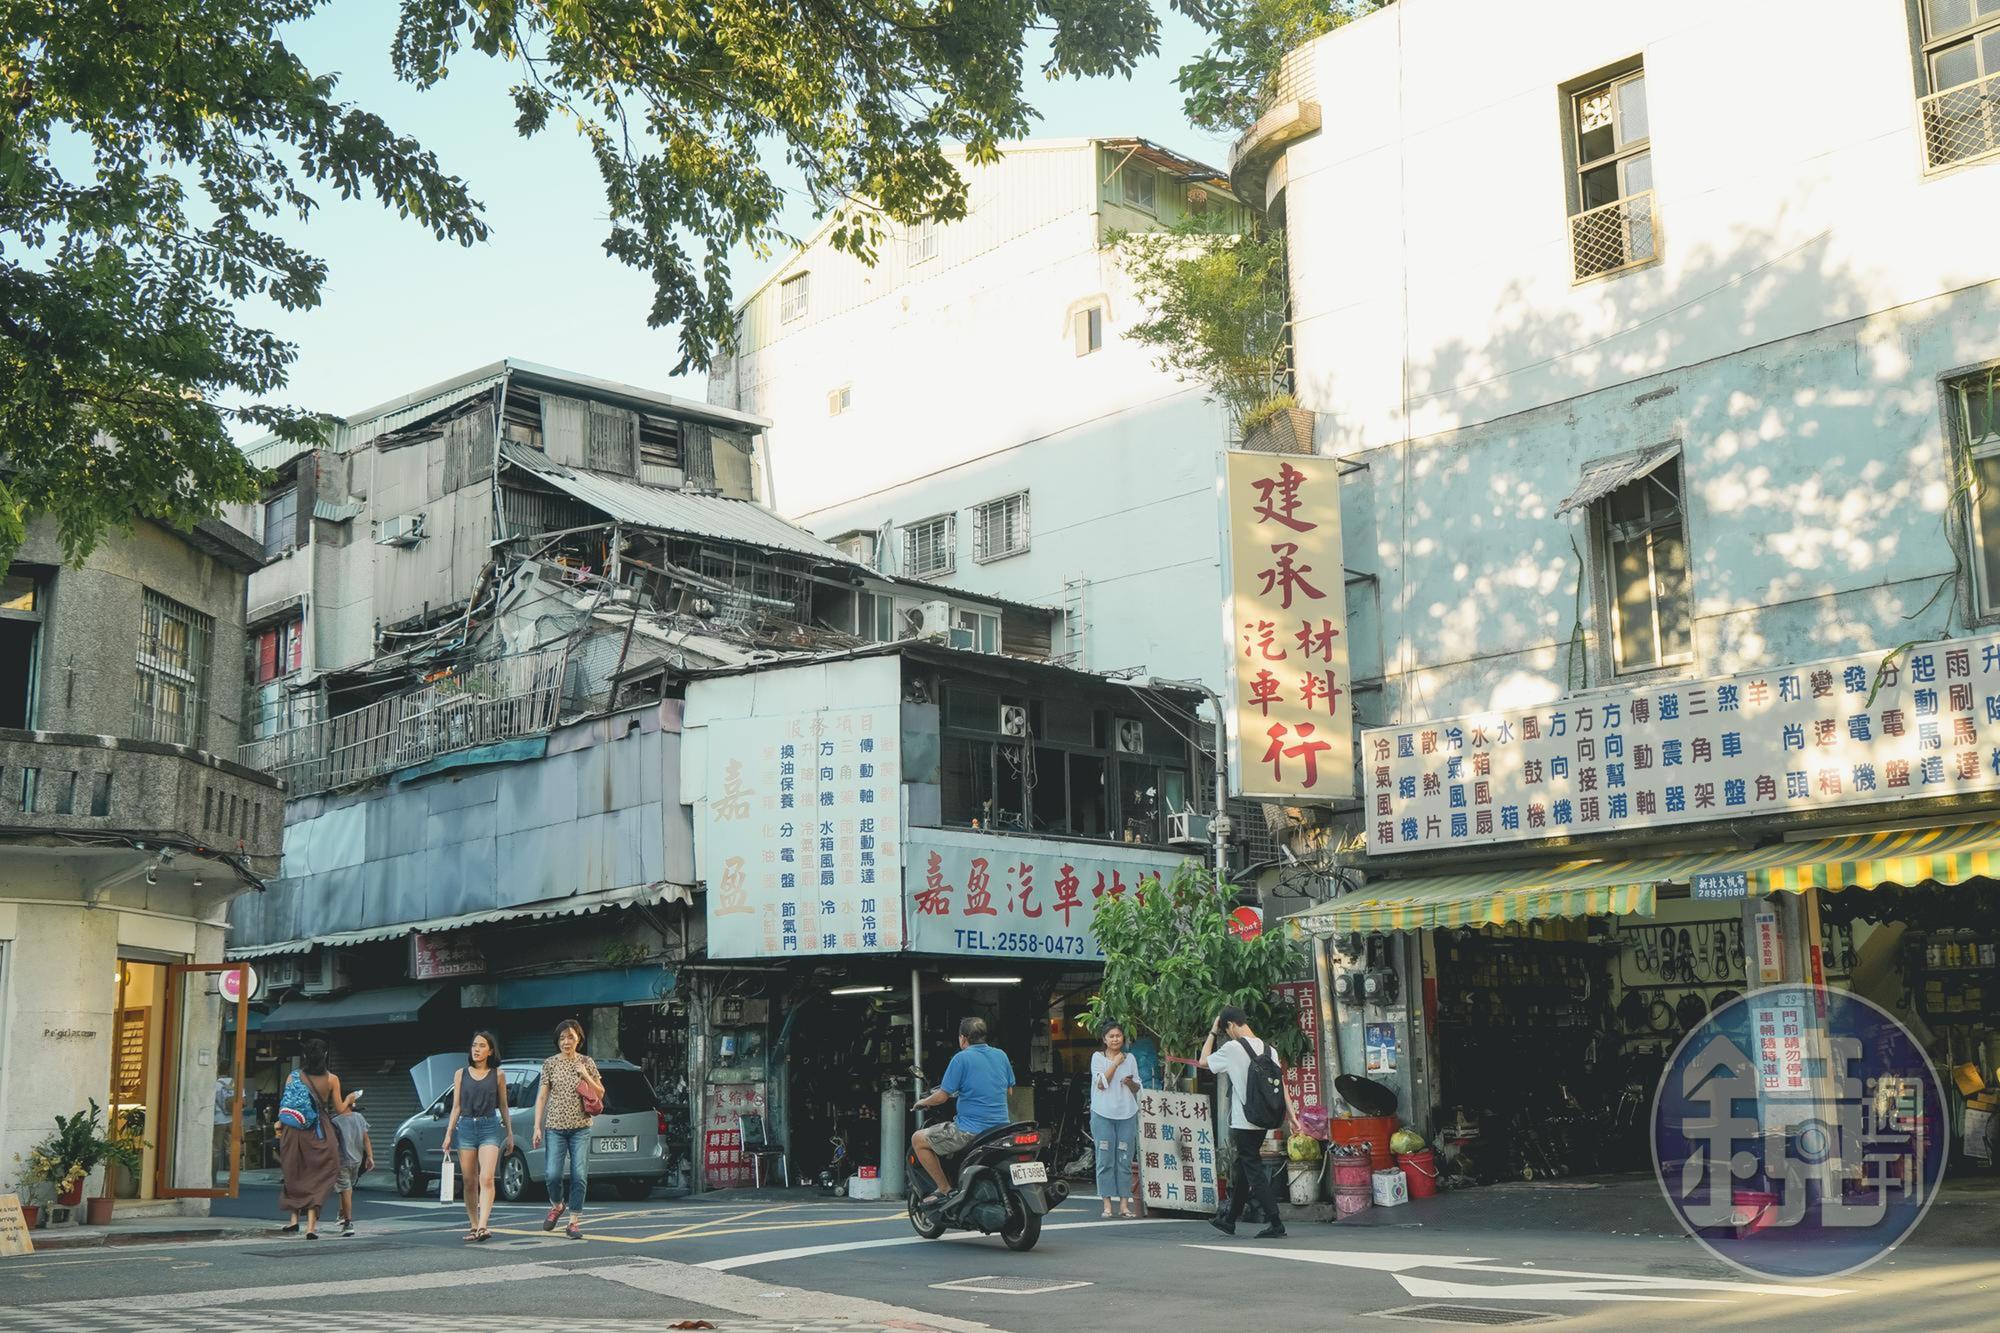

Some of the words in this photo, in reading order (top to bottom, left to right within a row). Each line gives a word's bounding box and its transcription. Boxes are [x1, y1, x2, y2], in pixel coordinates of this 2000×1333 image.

[1251, 462, 1327, 609] 建承
[1261, 722, 1331, 788] 行
[1549, 711, 1573, 825] 方向機
[1575, 707, 1600, 823] 方向接頭
[1602, 703, 1628, 819] 方向幫浦
[1630, 698, 1656, 816] 傳動軸
[1658, 693, 1685, 813] 避震器
[1688, 690, 1715, 809] 三角架
[1717, 684, 1746, 807] 煞車盤
[1748, 679, 1777, 801] 羊角
[1779, 675, 1809, 799] 和尚頭
[1810, 669, 1842, 795] 變速箱
[1843, 665, 1876, 792] 發電機
[1878, 660, 1910, 788] 分電盤
[1911, 654, 1945, 785] 起動馬達
[1946, 648, 1982, 781] 雨刷馬達
[780, 745, 794, 809] 換油保養
[820, 741, 834, 806] 方向機
[860, 738, 874, 803] 傳動軸
[1374, 738, 1394, 844] 冷氣風箱
[1397, 733, 1418, 841] 壓縮機
[1421, 730, 1442, 839] 散熱片
[1445, 727, 1468, 838] 冷氣風扇
[1471, 724, 1493, 835] 水箱風扇
[1497, 720, 1519, 830] 水箱
[1522, 716, 1546, 828] 風鼓機
[711, 758, 755, 917] 嘉盈
[780, 822, 795, 888] 分電盤
[820, 820, 834, 886] 水箱風扇
[860, 818, 875, 884] 起動馬達
[781, 902, 797, 951] 節氣門
[821, 900, 836, 949] 冷排
[861, 899, 877, 947] 加冷煤
[954, 929, 1084, 954] TEL:2558-0473
[1698, 887, 1745, 898] 28951080
[1760, 1012, 1779, 1088] 車輛隨時進出
[1782, 1010, 1802, 1087] 門前請勿停車
[1785, 995, 1797, 1004] 39
[1141, 1095, 1208, 1121] 建承汽材
[1144, 1122, 1162, 1199] 壓縮機
[1161, 1124, 1178, 1200] 散熱片
[1179, 1126, 1197, 1202] 冷氣風扇
[1197, 1128, 1215, 1204] 水箱風扇
